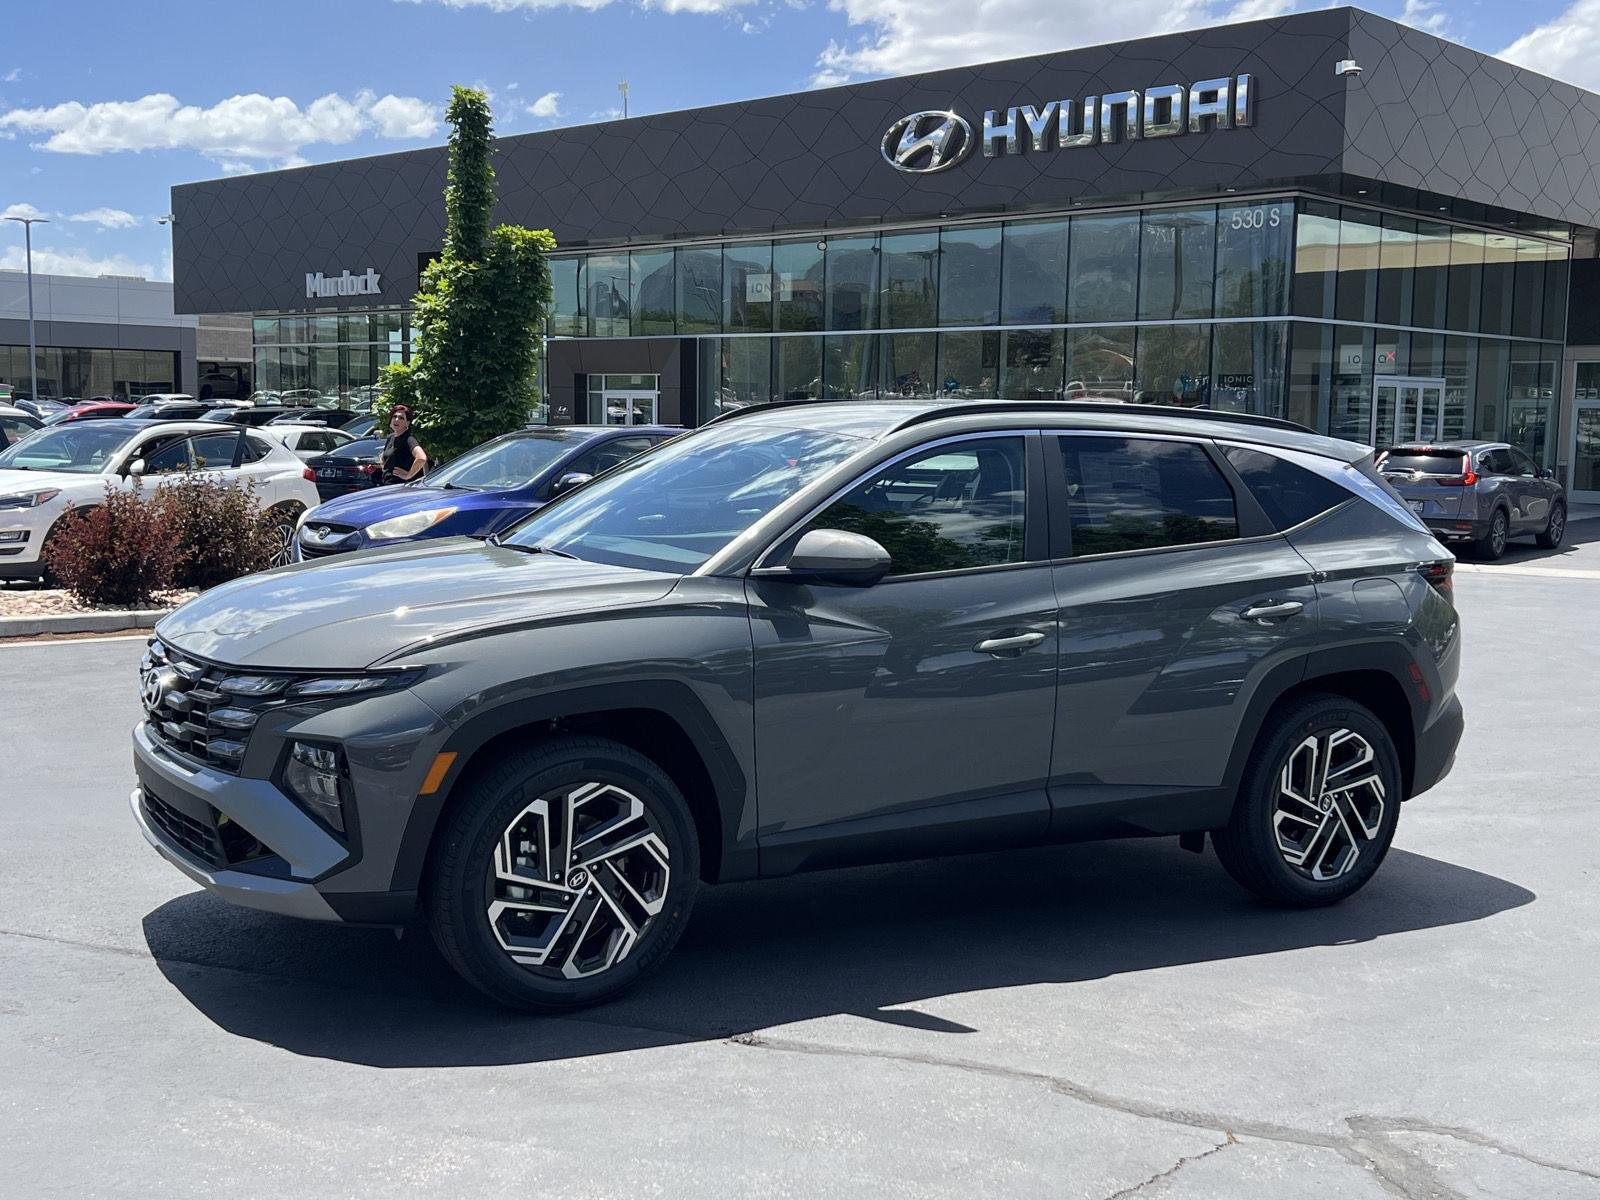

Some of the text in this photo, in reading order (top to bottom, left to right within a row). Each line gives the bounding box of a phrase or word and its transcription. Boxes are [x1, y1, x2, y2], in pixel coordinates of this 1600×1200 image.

[982, 73, 1254, 158] HYUNDAI
[1231, 207, 1280, 230] 530 S
[305, 267, 381, 298] Murdock
